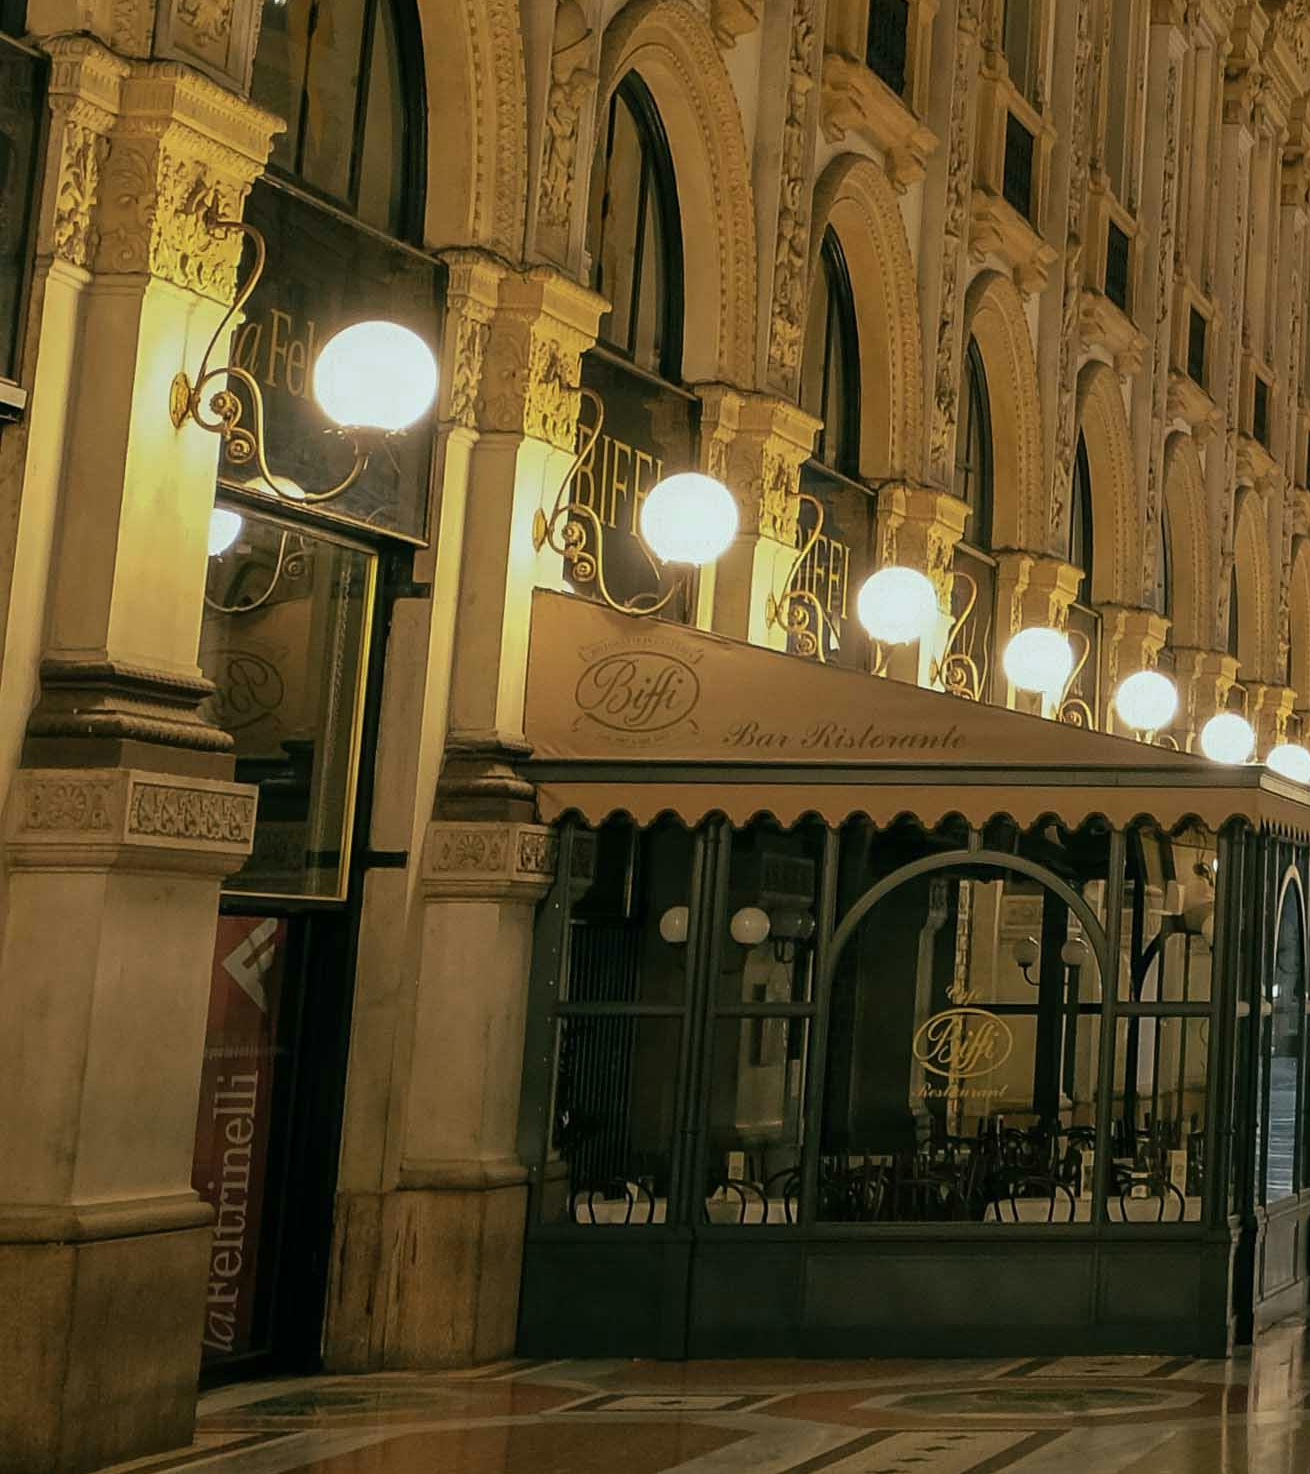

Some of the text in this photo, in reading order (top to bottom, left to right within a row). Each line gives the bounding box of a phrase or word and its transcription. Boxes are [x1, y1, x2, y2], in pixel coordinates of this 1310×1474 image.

[571, 423, 664, 537] BIFF
[583, 657, 686, 728] Biffi
[721, 721, 967, 750] Bar Ristorante
